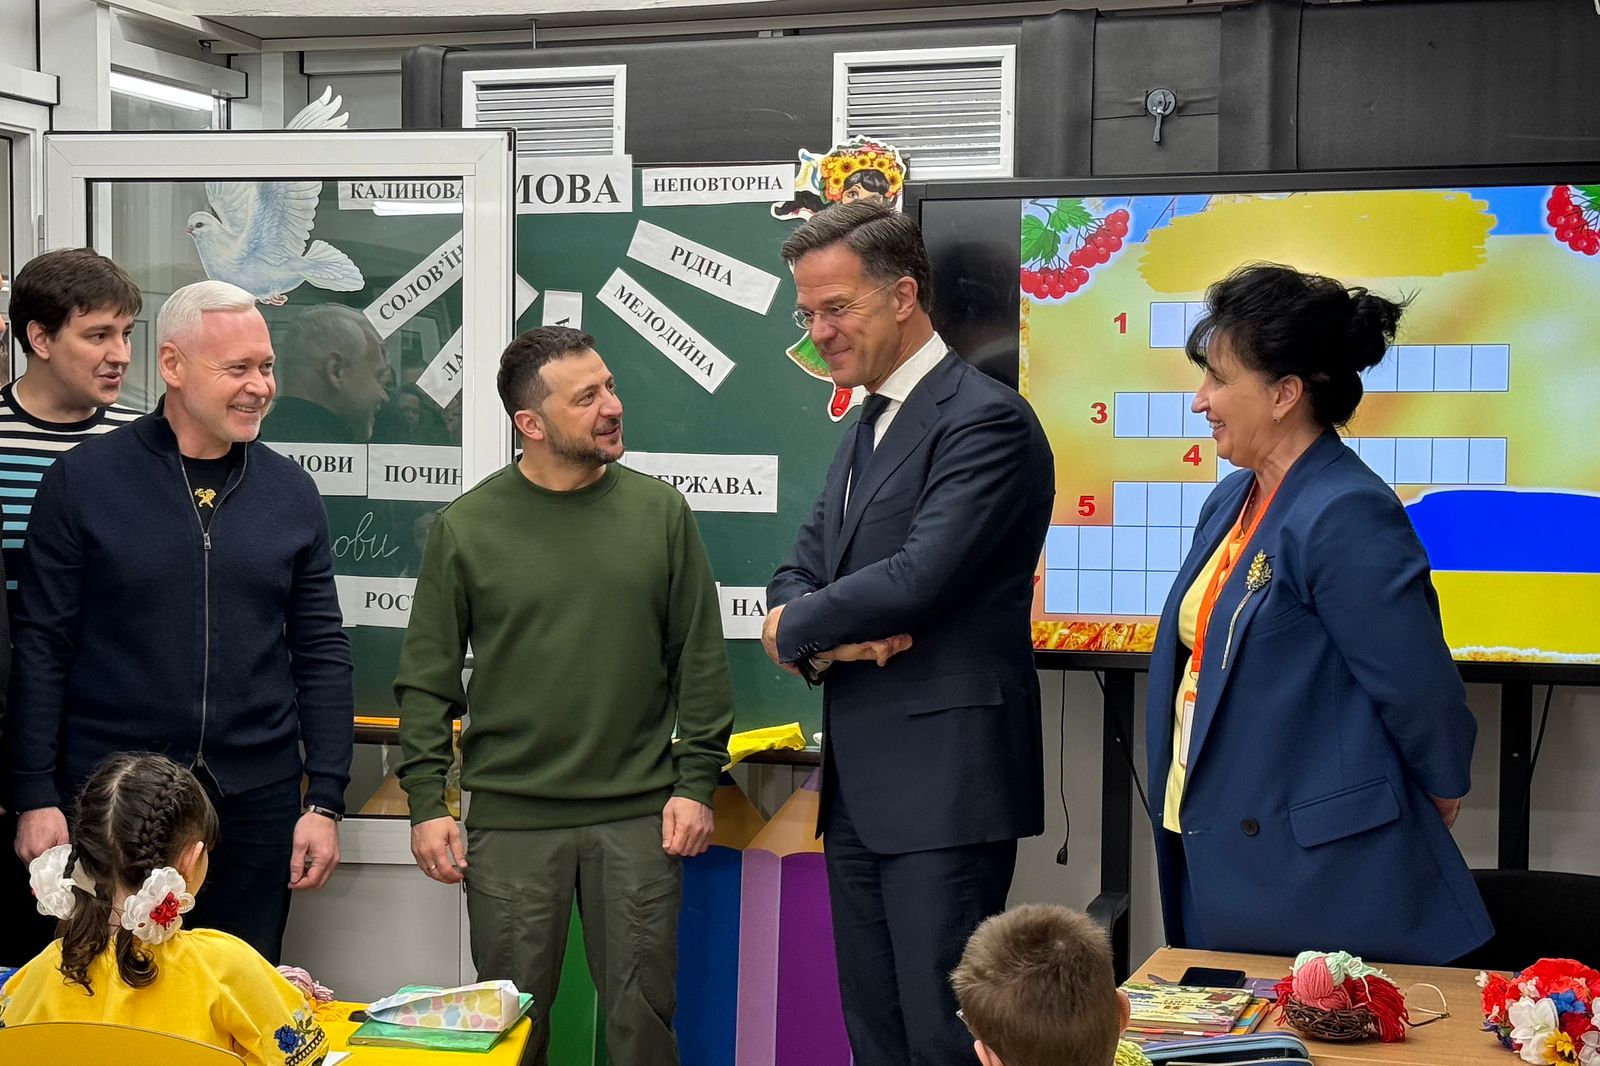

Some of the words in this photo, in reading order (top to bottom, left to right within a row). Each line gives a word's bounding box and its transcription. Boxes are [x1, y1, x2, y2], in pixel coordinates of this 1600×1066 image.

[653, 175, 783, 192] НЕПОВТОРНА
[669, 244, 733, 287] РІДНА
[613, 283, 716, 378] МЕЛОДІЙНА
[1113, 312, 1127, 334] 1
[442, 345, 463, 381] ЛА
[1090, 402, 1108, 424] 3
[1182, 444, 1202, 466] 4
[384, 464, 462, 485] ПОЧИН
[650, 474, 763, 496] РЖАВА.
[1077, 495, 1096, 517] 5
[364, 591, 415, 612] РОС
[732, 598, 766, 616] НА
